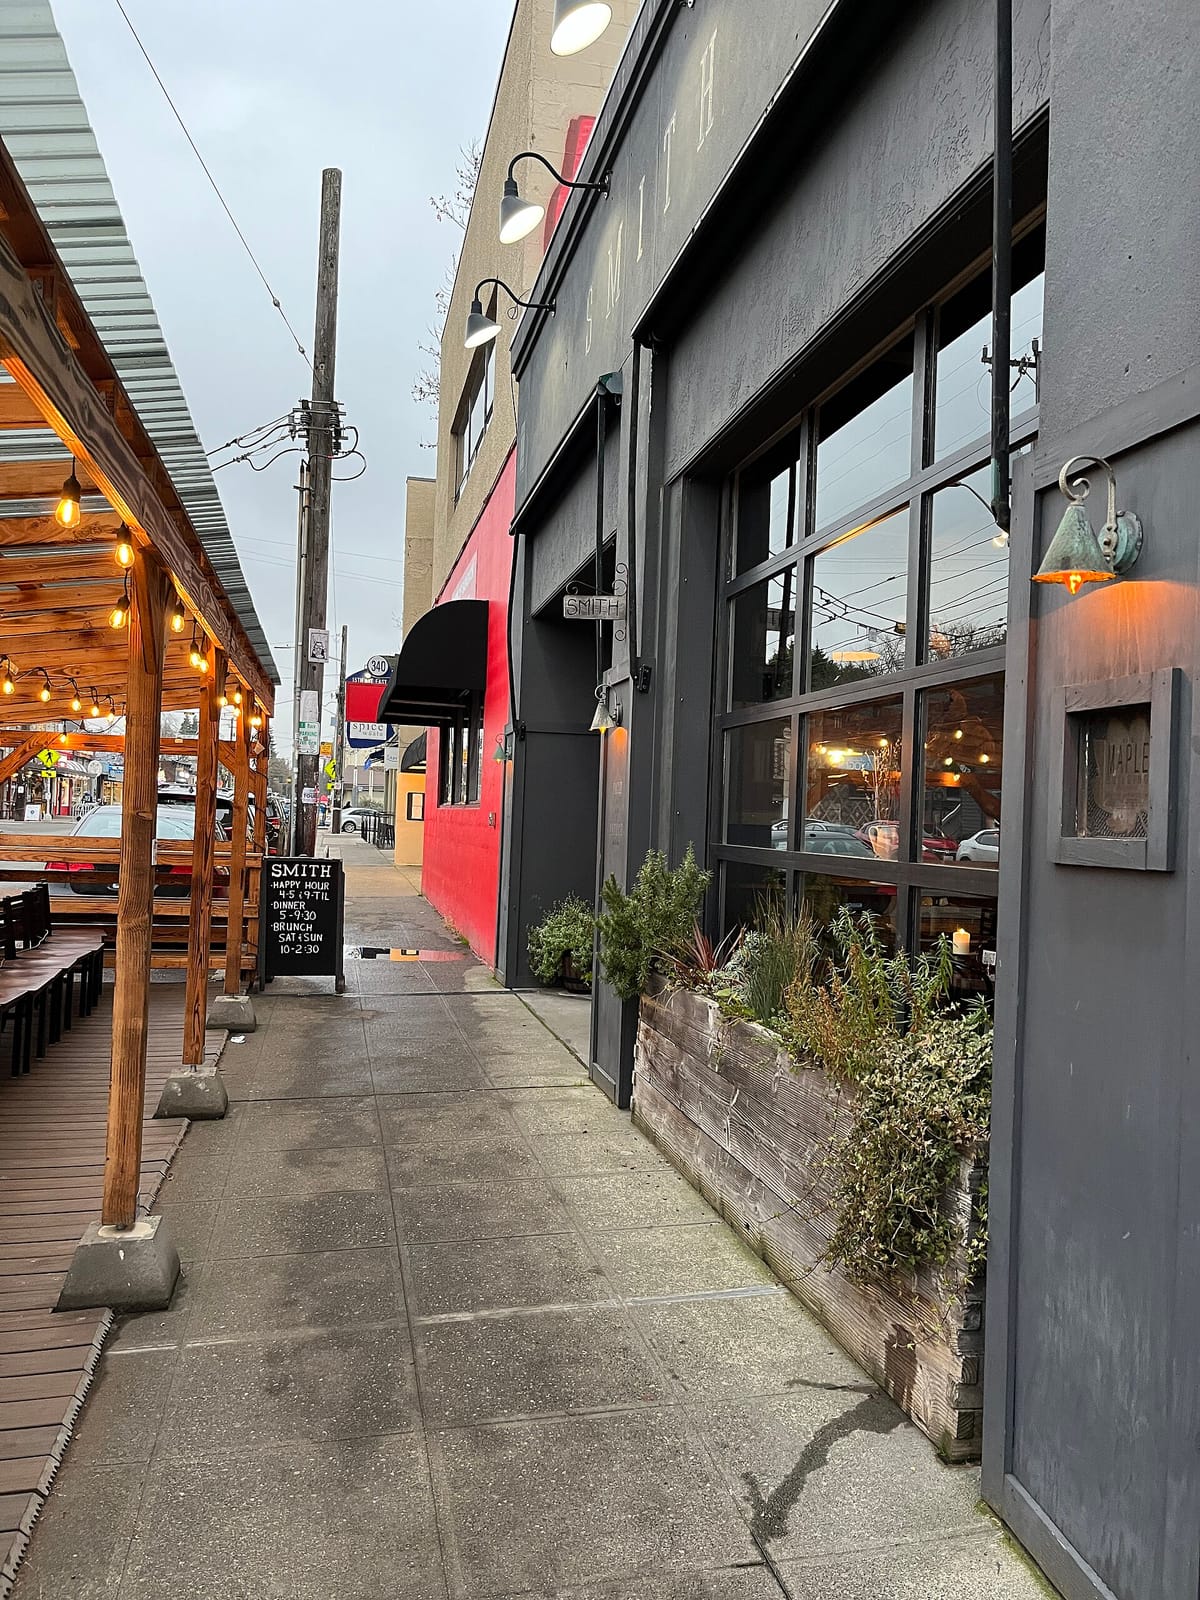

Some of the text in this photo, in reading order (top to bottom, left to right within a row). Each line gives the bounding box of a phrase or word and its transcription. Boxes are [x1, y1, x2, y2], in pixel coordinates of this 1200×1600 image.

[585, 29, 718, 356] SMITH
[566, 598, 619, 616] SMITH
[371, 660, 386, 672] 340
[352, 723, 384, 732] spice
[271, 863, 332, 878] SMITH
[273, 880, 330, 891] HAPPY HOUR
[273, 901, 306, 910] DINNER
[273, 922, 313, 932] BRUNCH
[278, 933, 296, 943] SAT
[303, 933, 324, 942] SUN
